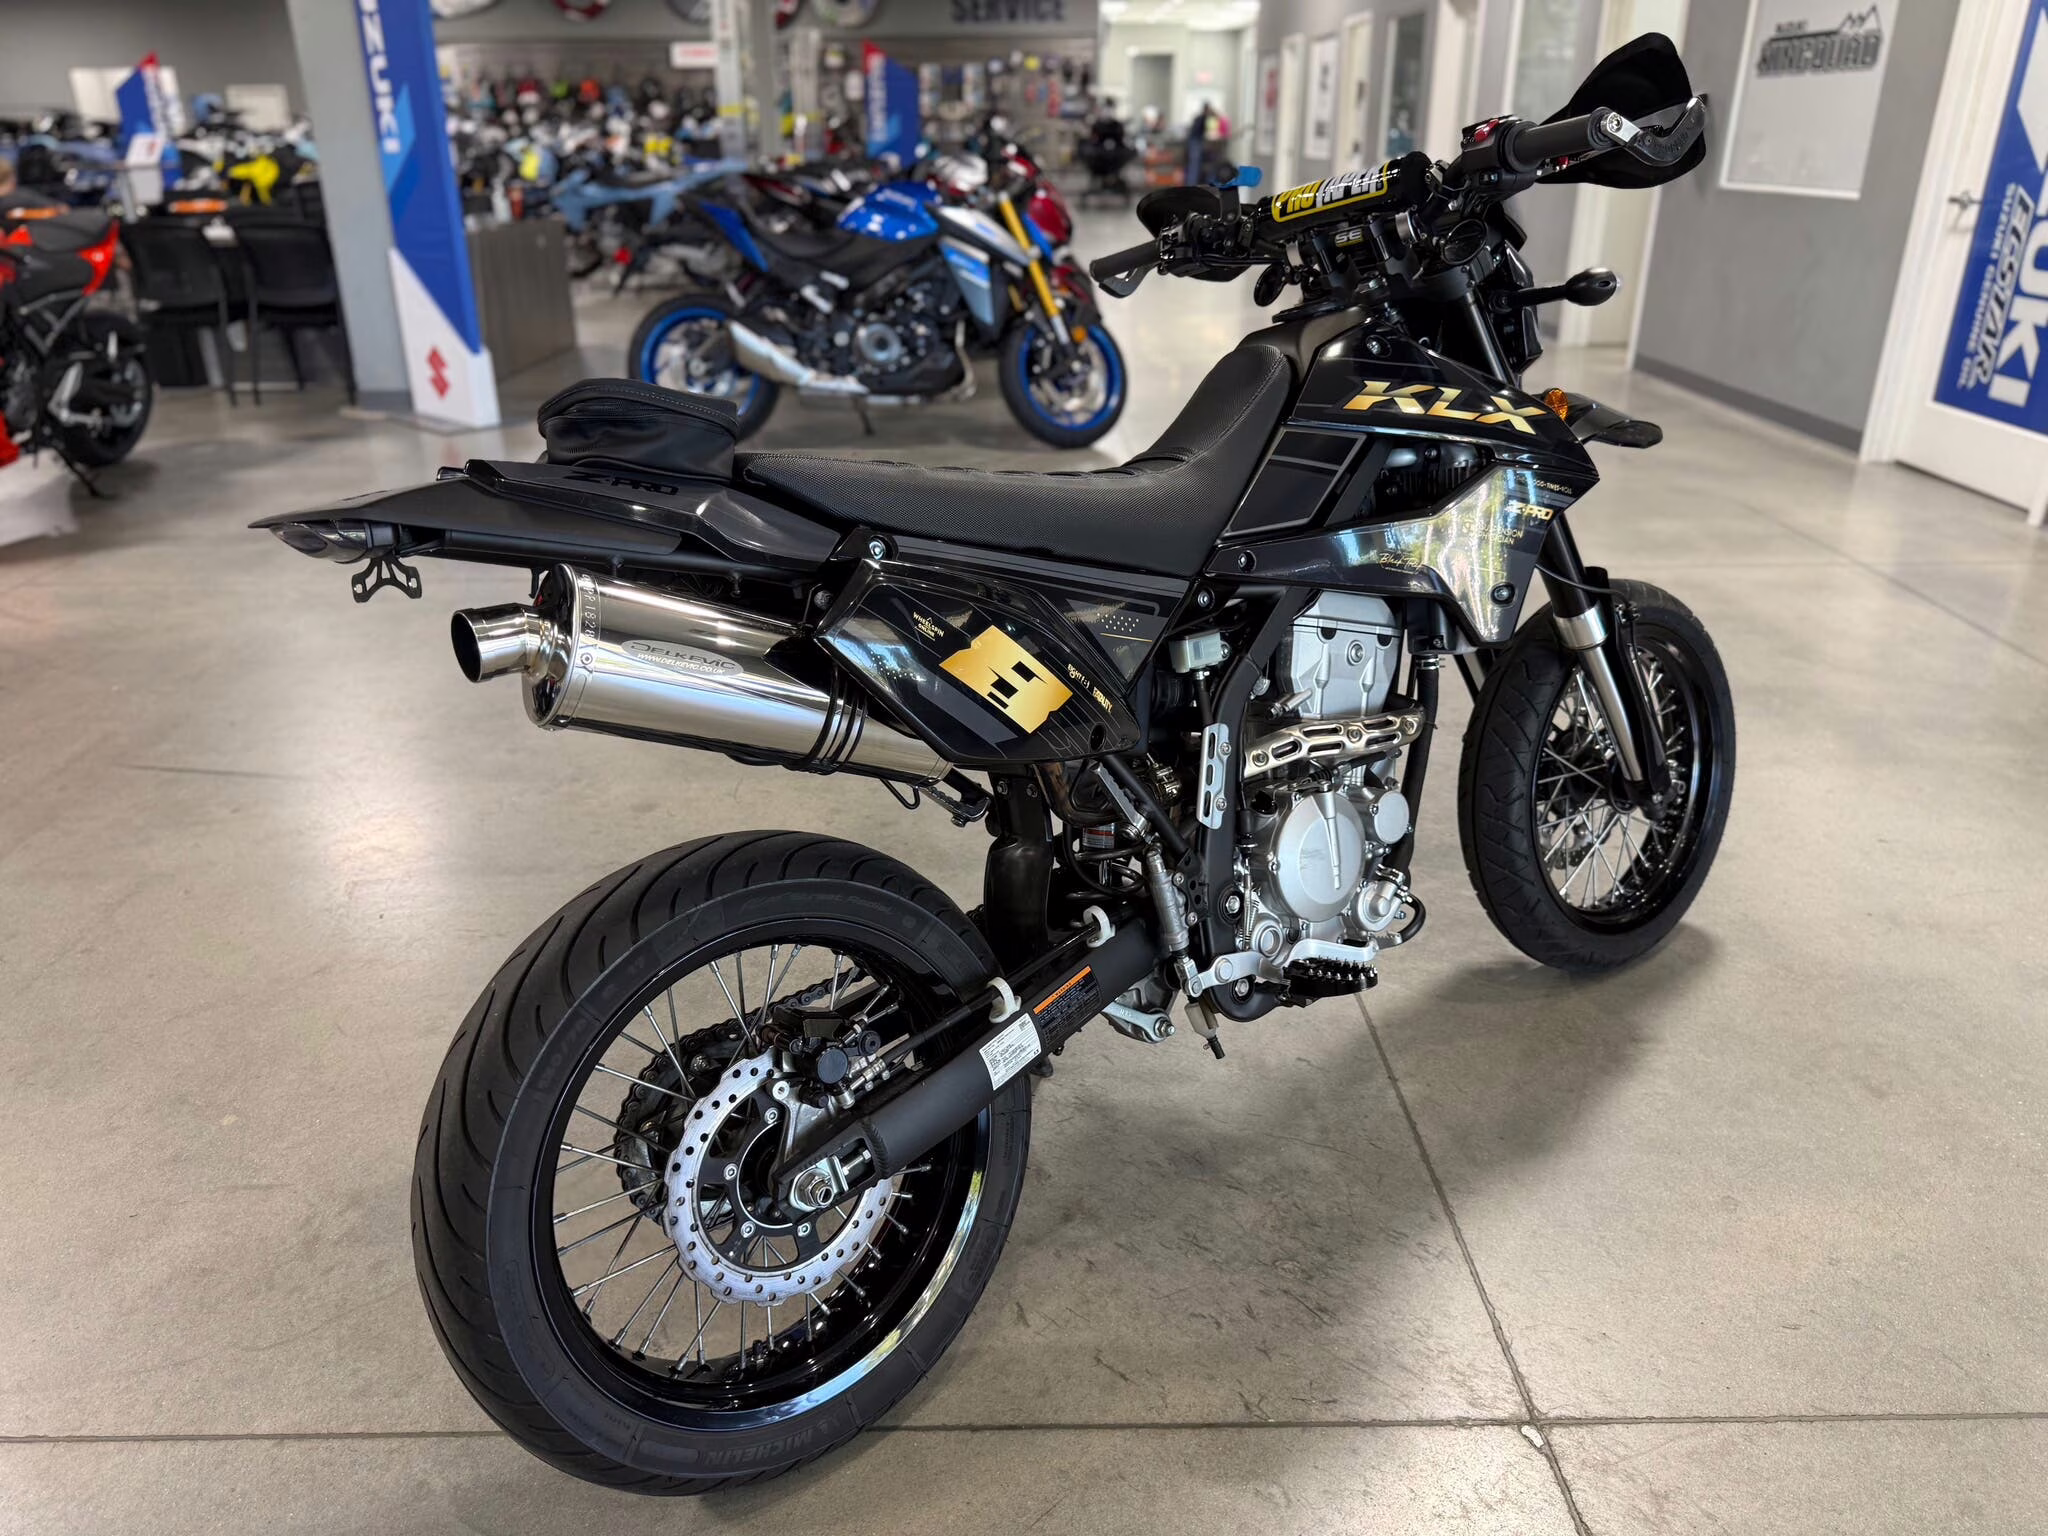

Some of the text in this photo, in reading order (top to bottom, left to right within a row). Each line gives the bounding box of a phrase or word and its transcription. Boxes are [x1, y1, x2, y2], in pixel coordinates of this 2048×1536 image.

[358, 0, 402, 154] ZUKI
[1986, 165, 2048, 407] UKI
[1343, 380, 1547, 435] KLX
[631, 641, 736, 670] DELKEVIC
[703, 1429, 813, 1465] MICHELIN
